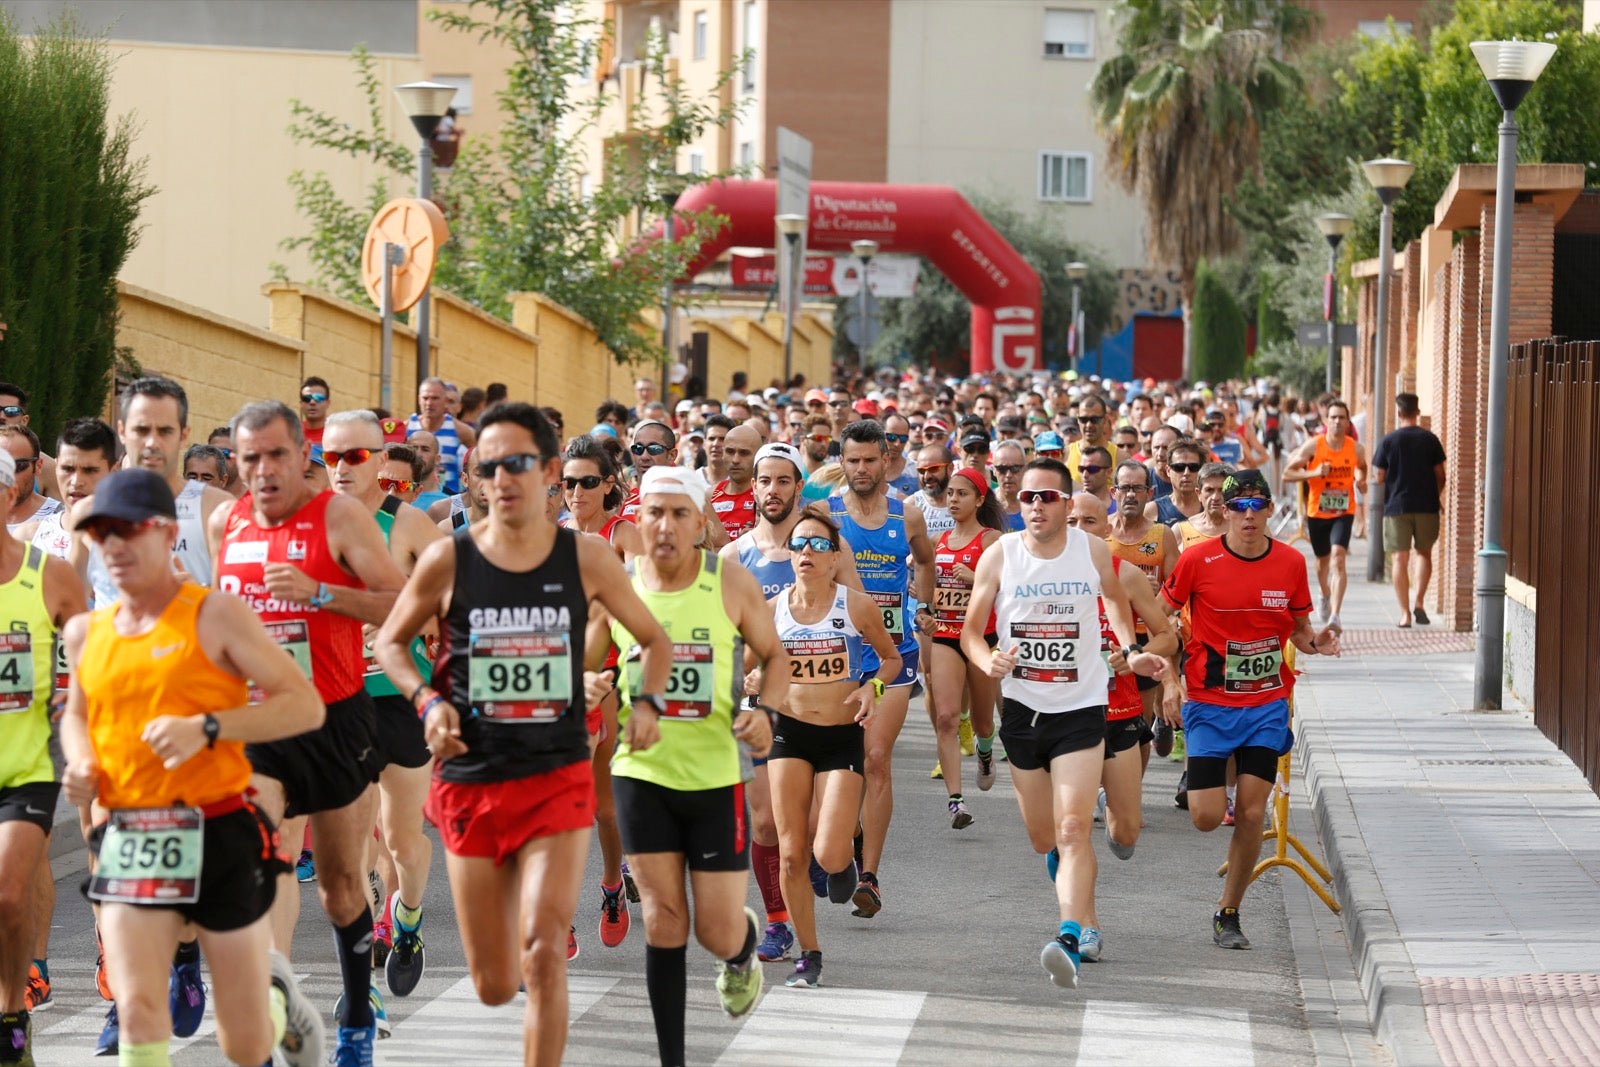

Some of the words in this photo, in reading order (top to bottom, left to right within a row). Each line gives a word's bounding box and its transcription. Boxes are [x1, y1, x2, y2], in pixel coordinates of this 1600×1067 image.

[813, 195, 897, 213] Diputación
[813, 214, 829, 230] de
[832, 214, 897, 232] Granada
[952, 229, 1010, 289] DEPORTES
[937, 591, 971, 607] 2122
[1015, 582, 1092, 598] ANGUITA
[468, 606, 571, 628] GRANADA
[1048, 604, 1074, 615] Otura
[1020, 641, 1075, 662] 3062
[790, 657, 845, 678] 2149
[1236, 655, 1275, 677] 460
[488, 662, 551, 693] 981
[119, 836, 183, 869] 956
